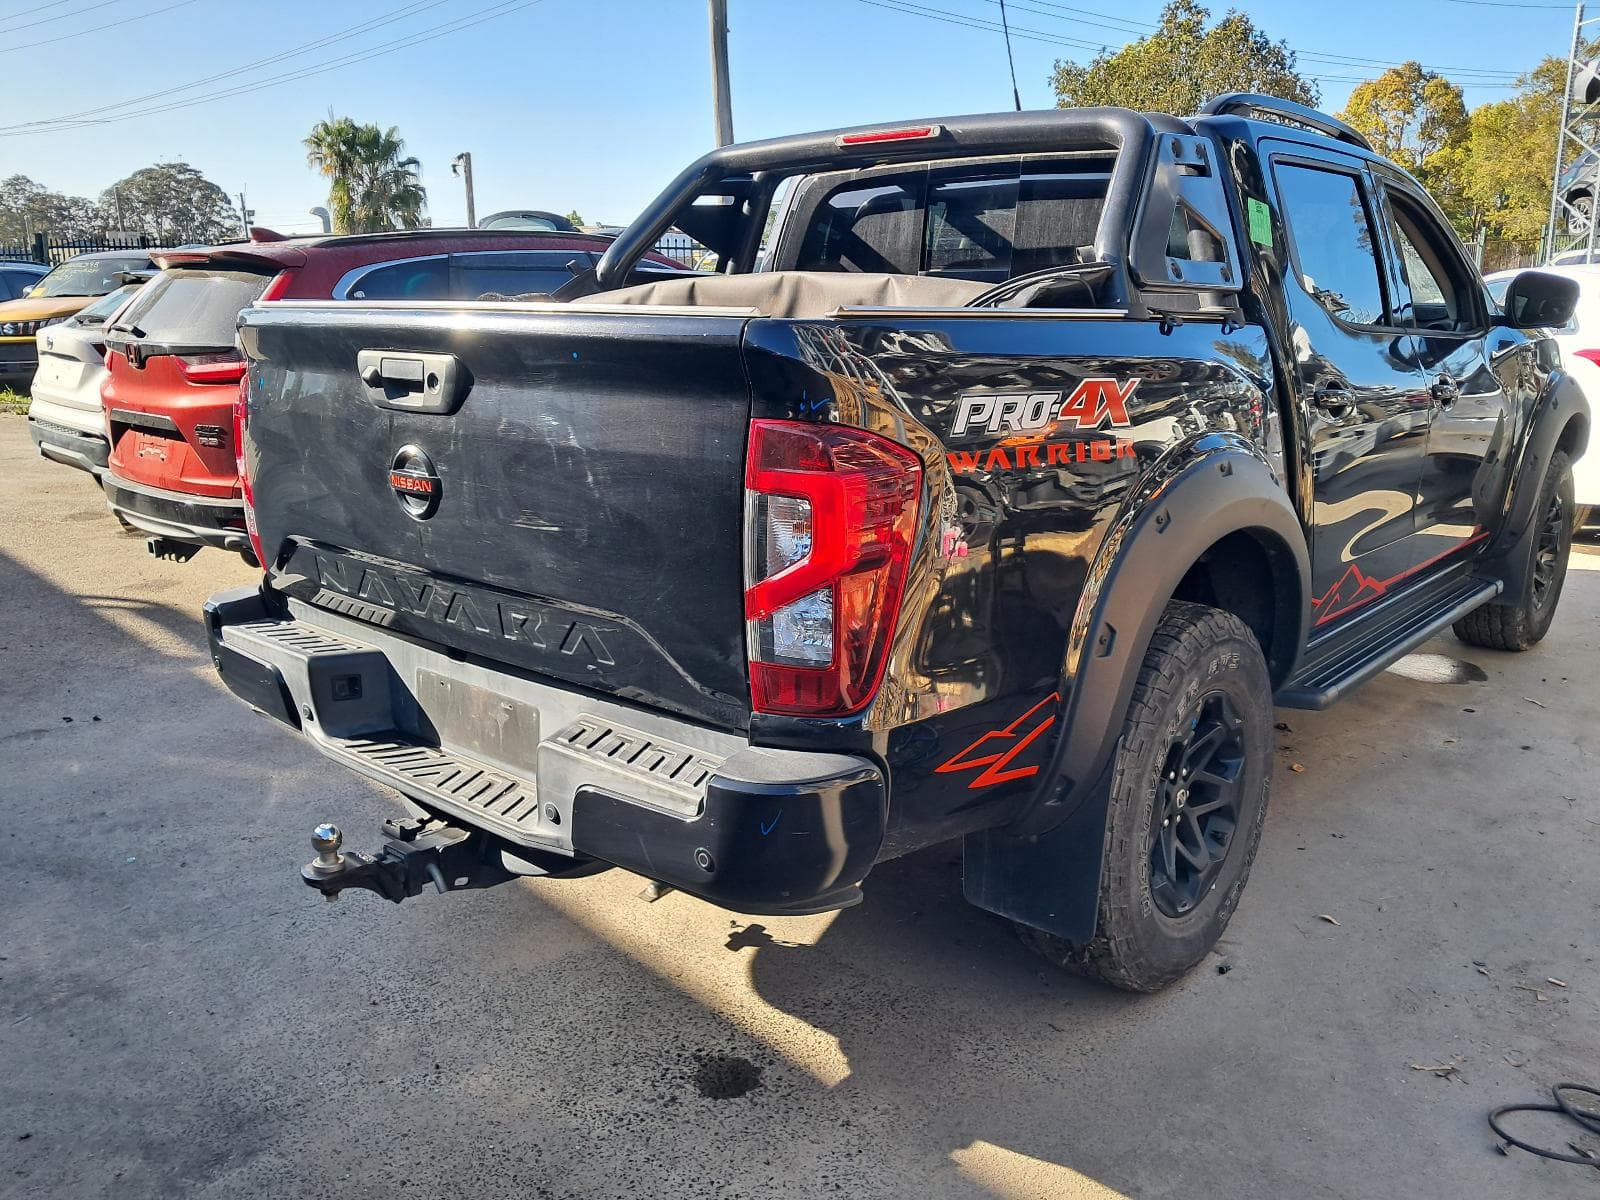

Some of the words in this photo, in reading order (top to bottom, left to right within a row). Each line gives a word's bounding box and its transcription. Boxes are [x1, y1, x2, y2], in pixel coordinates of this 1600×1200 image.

[950, 377, 1142, 438] PRO-4X
[946, 438, 1137, 475] WARRIOR
[391, 474, 433, 493] NISSAN
[314, 553, 616, 666] NAVARA
